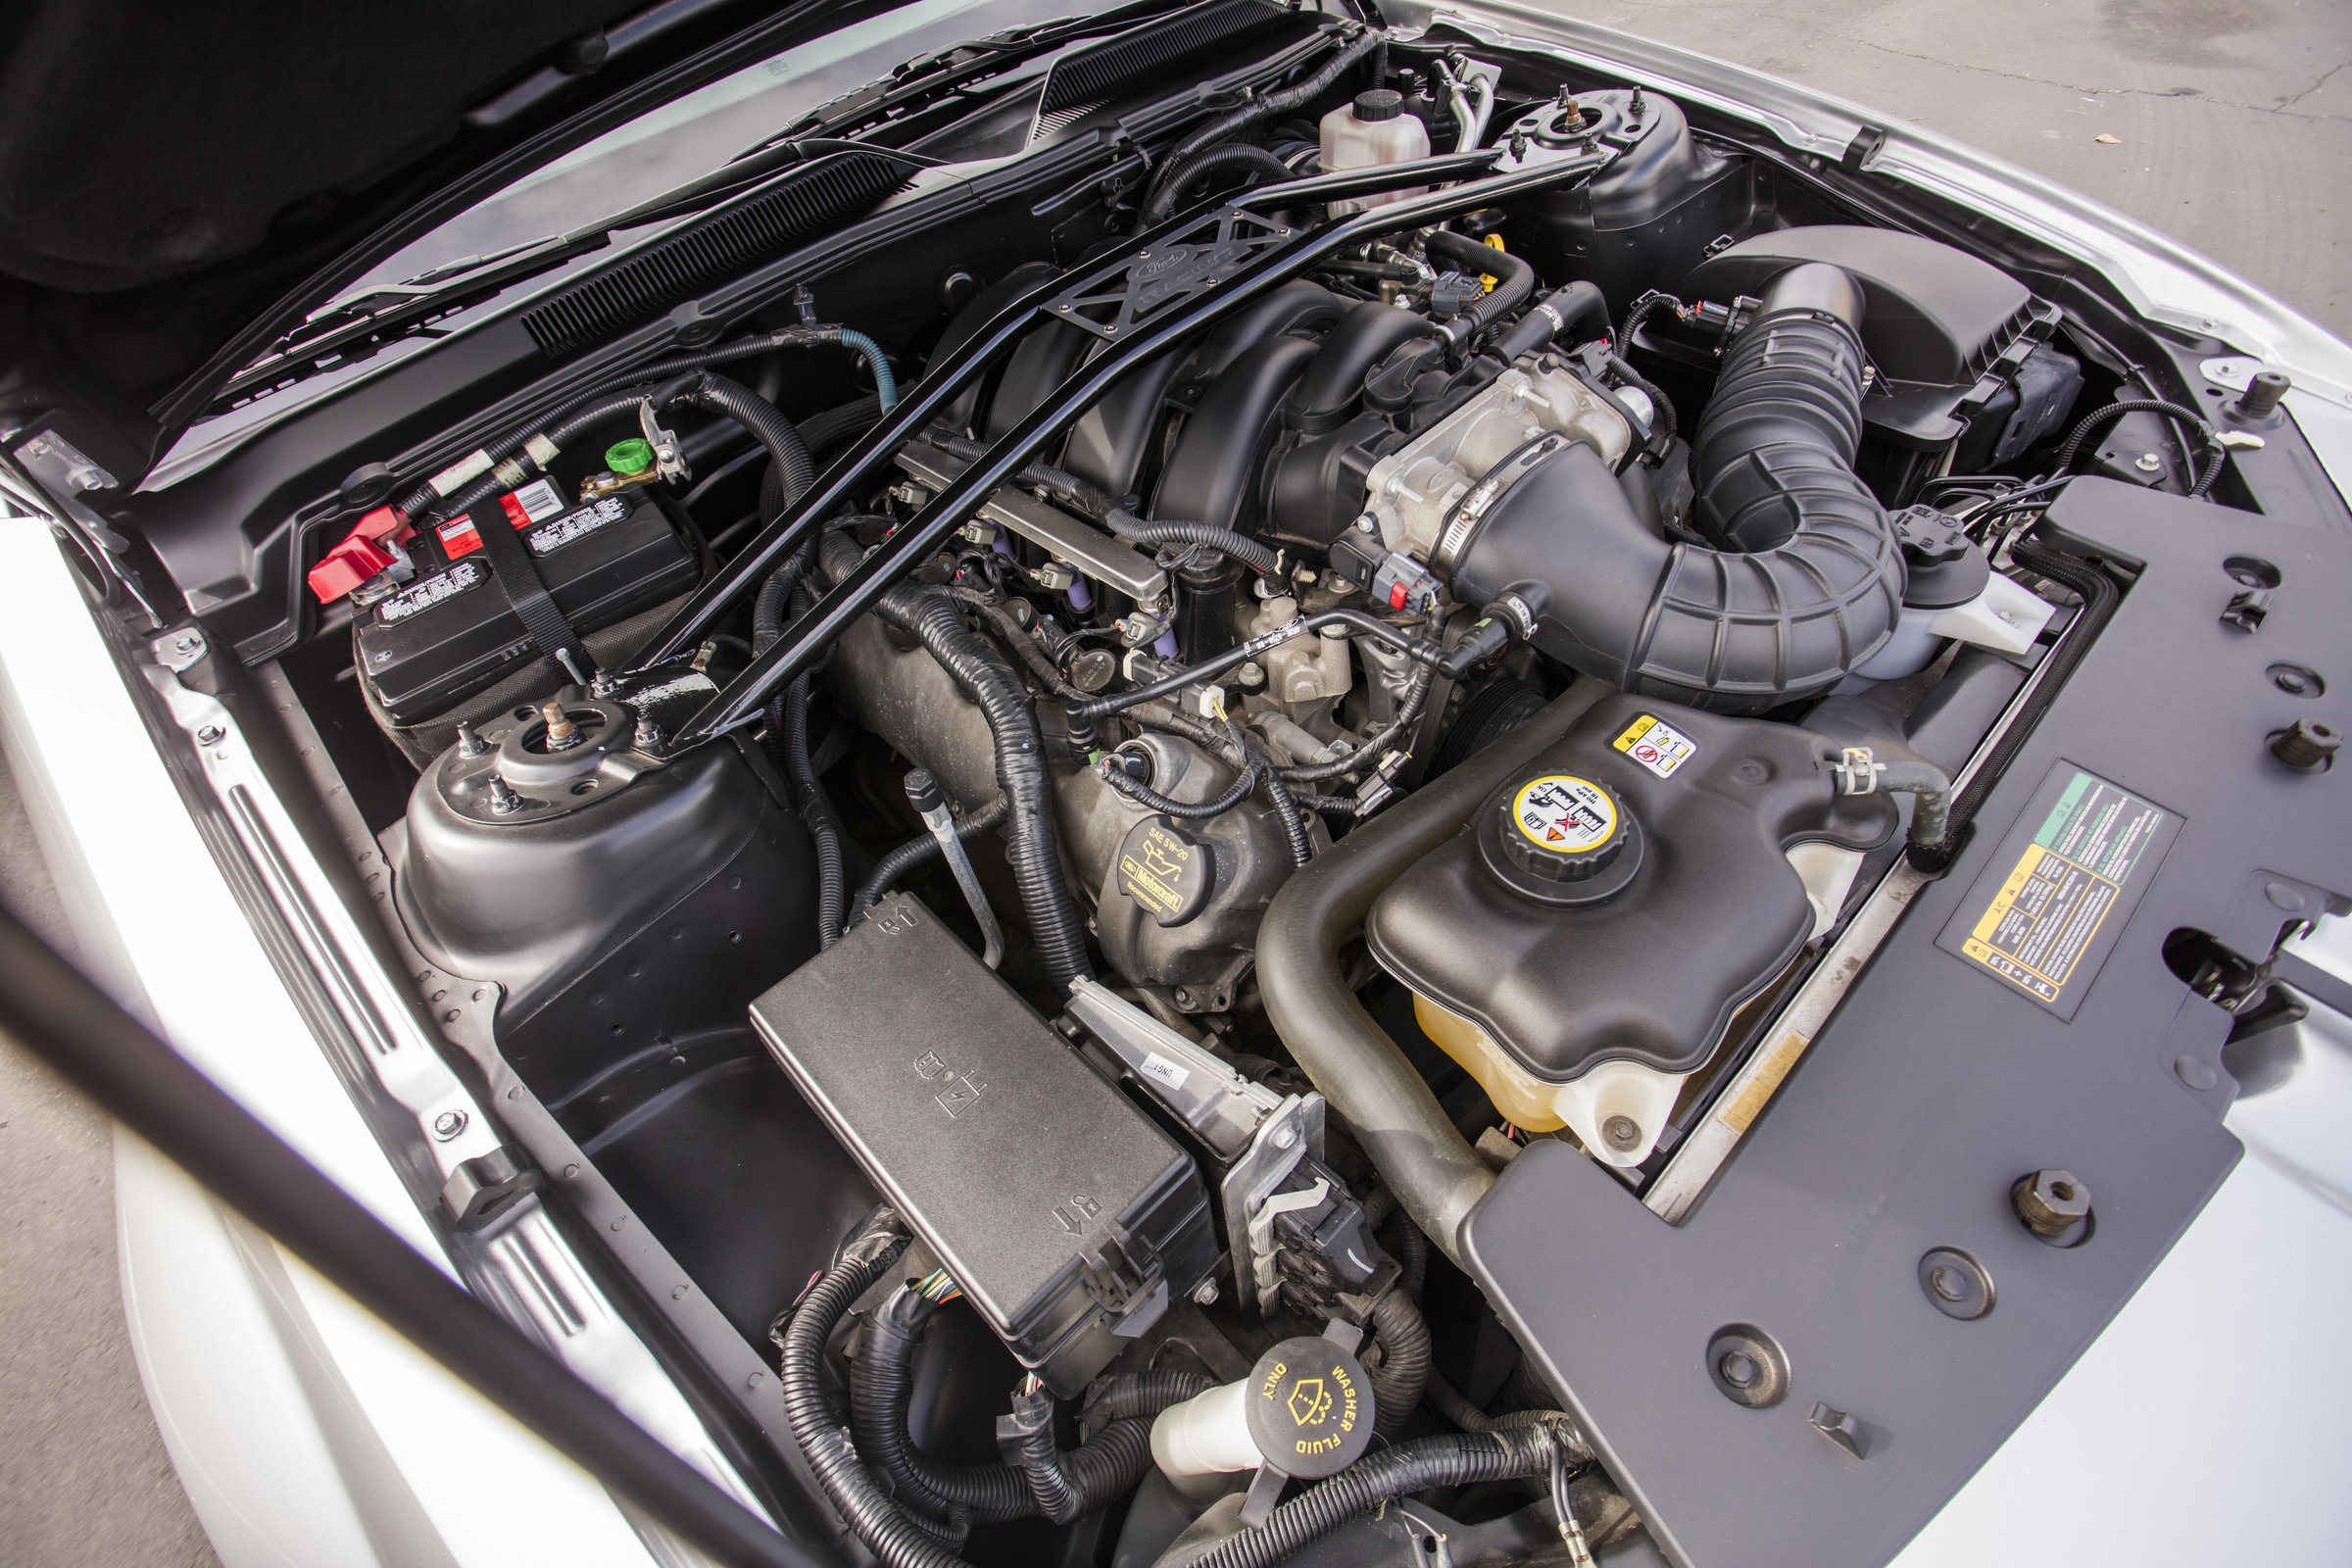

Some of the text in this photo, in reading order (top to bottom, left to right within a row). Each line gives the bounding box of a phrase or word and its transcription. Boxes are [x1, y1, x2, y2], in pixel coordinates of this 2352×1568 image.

[1145, 252, 1180, 274] Ford
[1149, 827, 1188, 860] SAE 5W-20
[1126, 880, 1162, 912] Recommended
[1137, 868, 1179, 907] Motorcraft
[1262, 1362, 1357, 1454] WASHER FLUID ONLY
